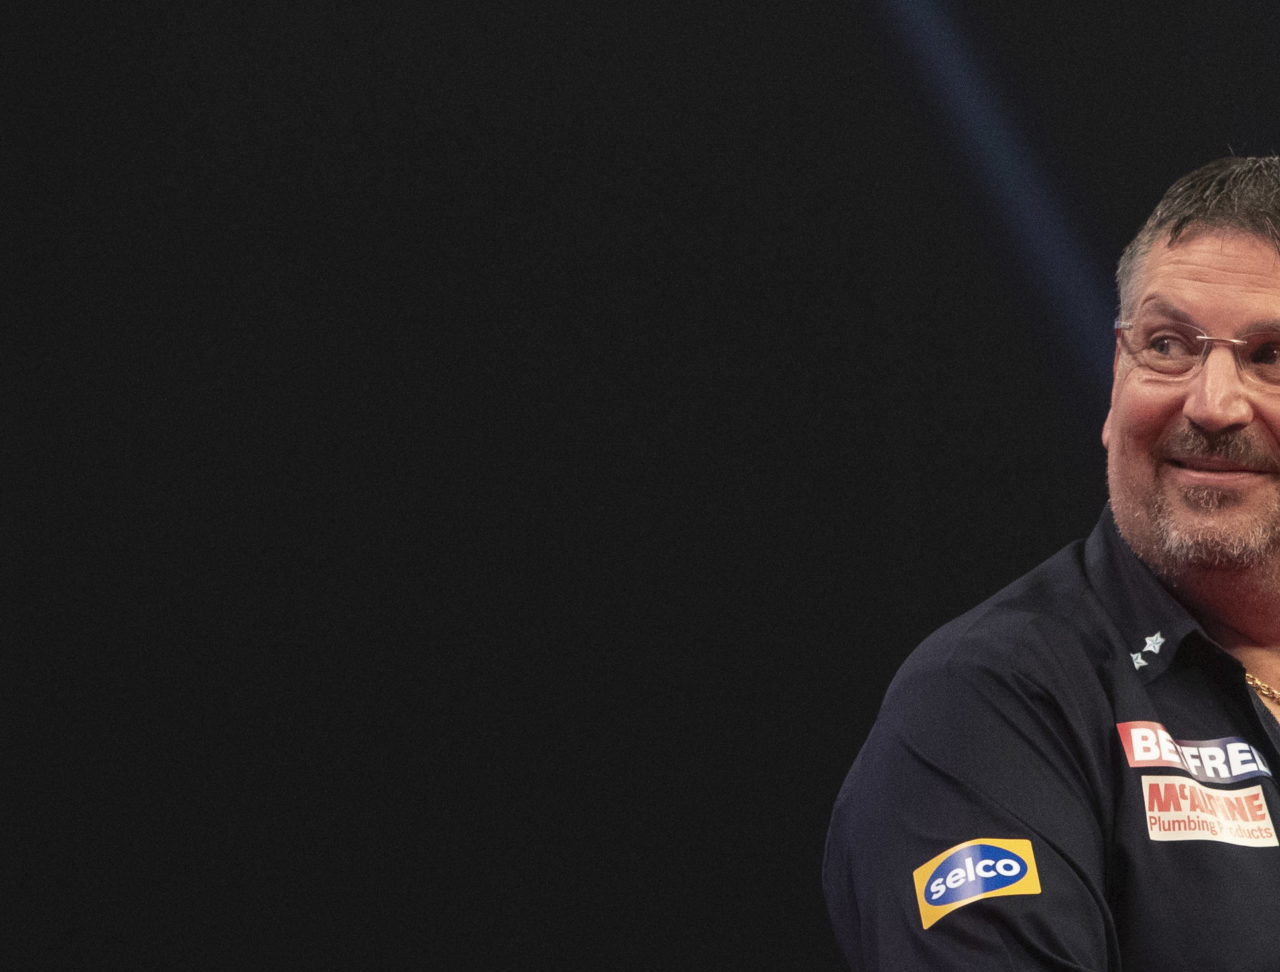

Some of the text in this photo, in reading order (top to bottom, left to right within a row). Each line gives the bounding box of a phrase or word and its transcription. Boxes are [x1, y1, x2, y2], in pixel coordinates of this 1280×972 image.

[1131, 728, 1271, 778] BEFRE
[1150, 816, 1218, 836] Plumbing
[929, 856, 1021, 900] selco
